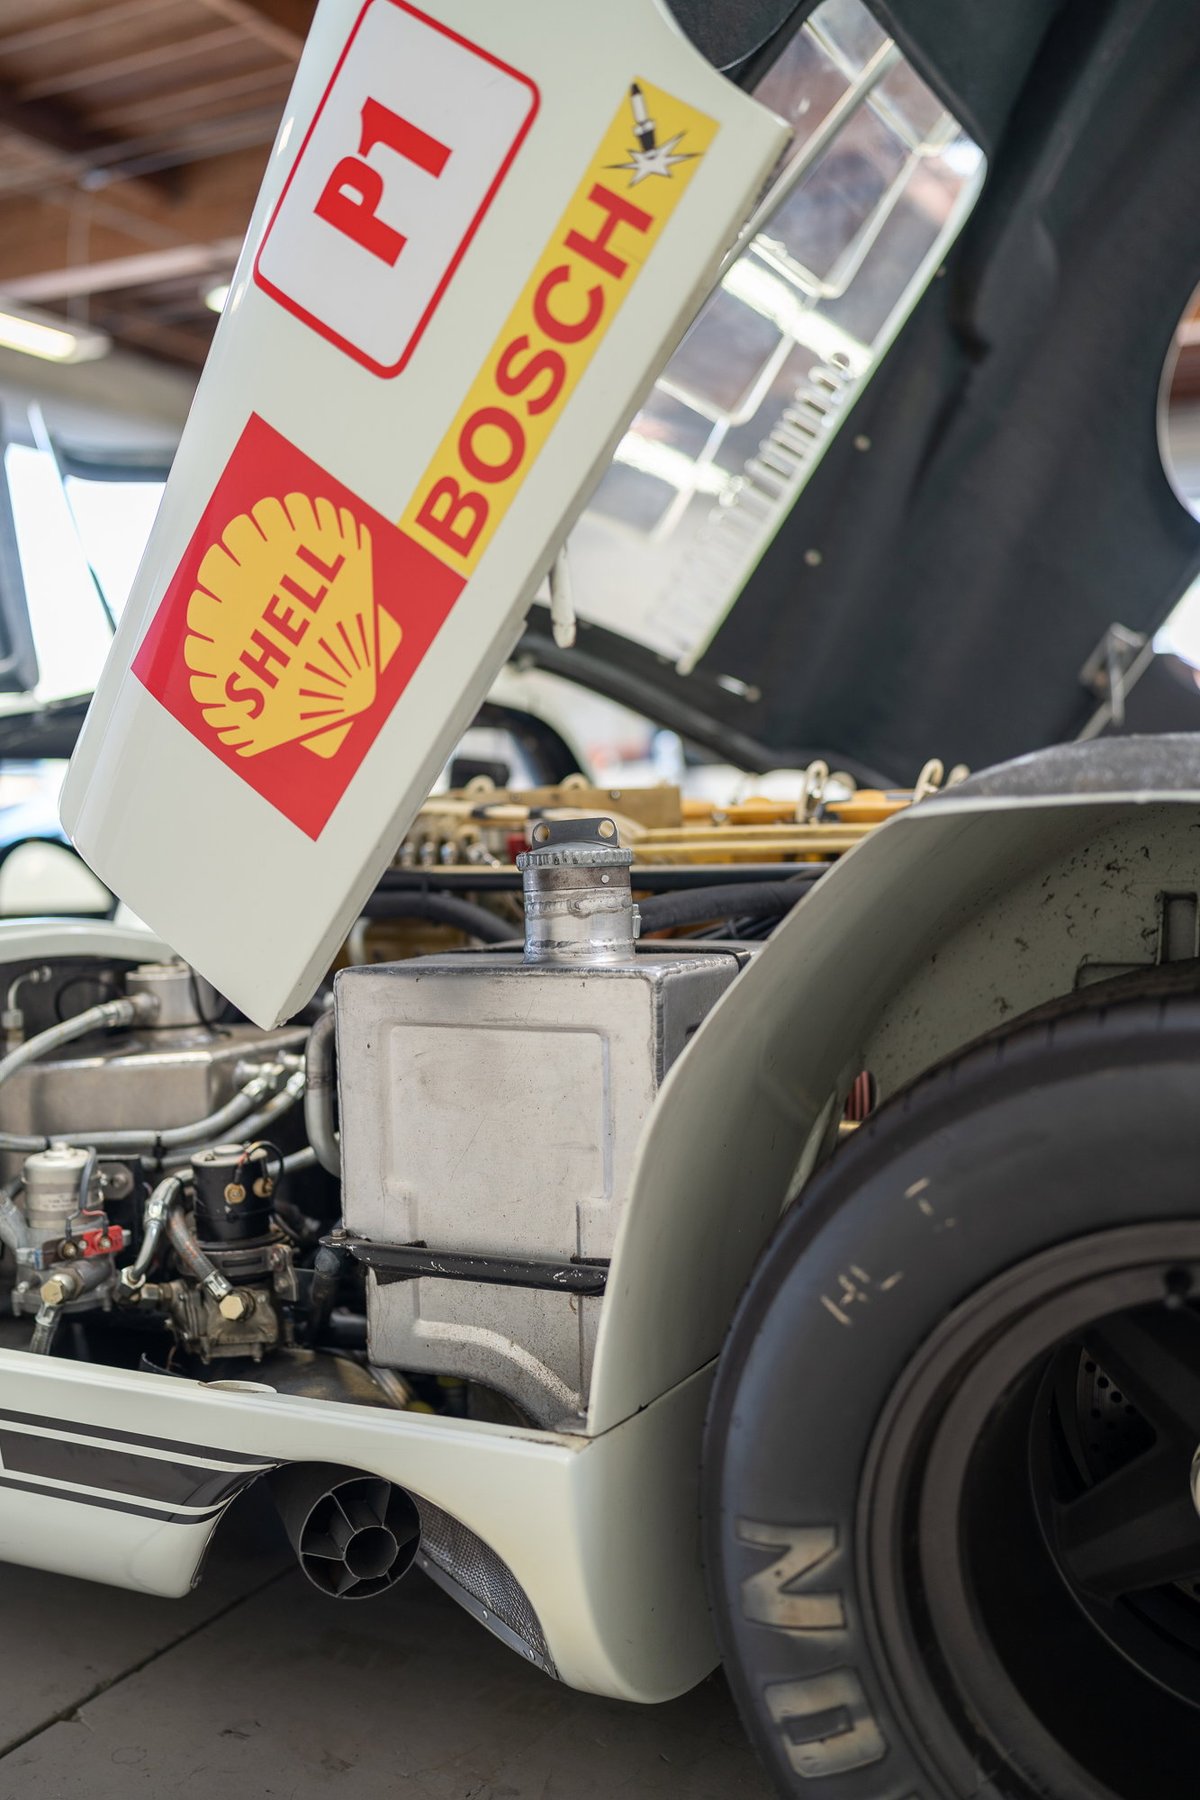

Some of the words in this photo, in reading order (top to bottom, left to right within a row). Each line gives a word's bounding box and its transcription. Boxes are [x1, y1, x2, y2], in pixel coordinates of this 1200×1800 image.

[313, 96, 452, 268] P1
[415, 183, 654, 558] BOSCH
[225, 543, 346, 720] SHELL
